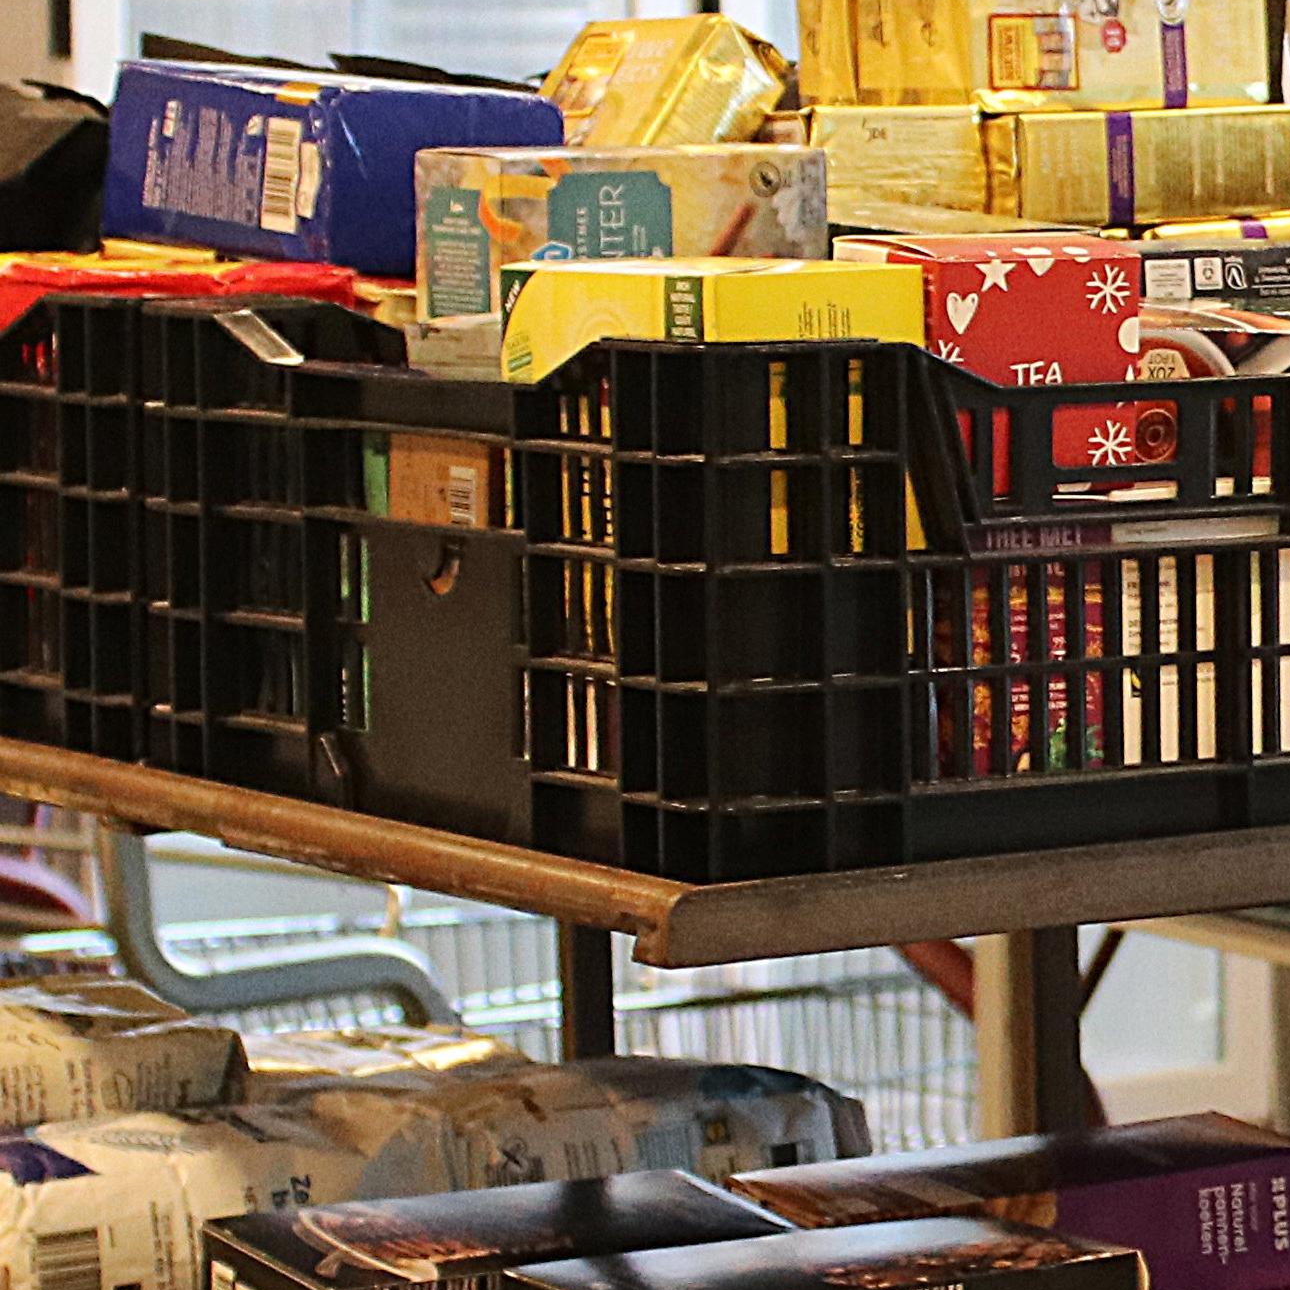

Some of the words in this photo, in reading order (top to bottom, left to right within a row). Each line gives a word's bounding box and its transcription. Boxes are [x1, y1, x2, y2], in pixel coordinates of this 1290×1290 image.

[505, 279, 521, 313] NEW
[1010, 361, 1063, 387] TEA
[1272, 1194, 1290, 1252] PLUS
